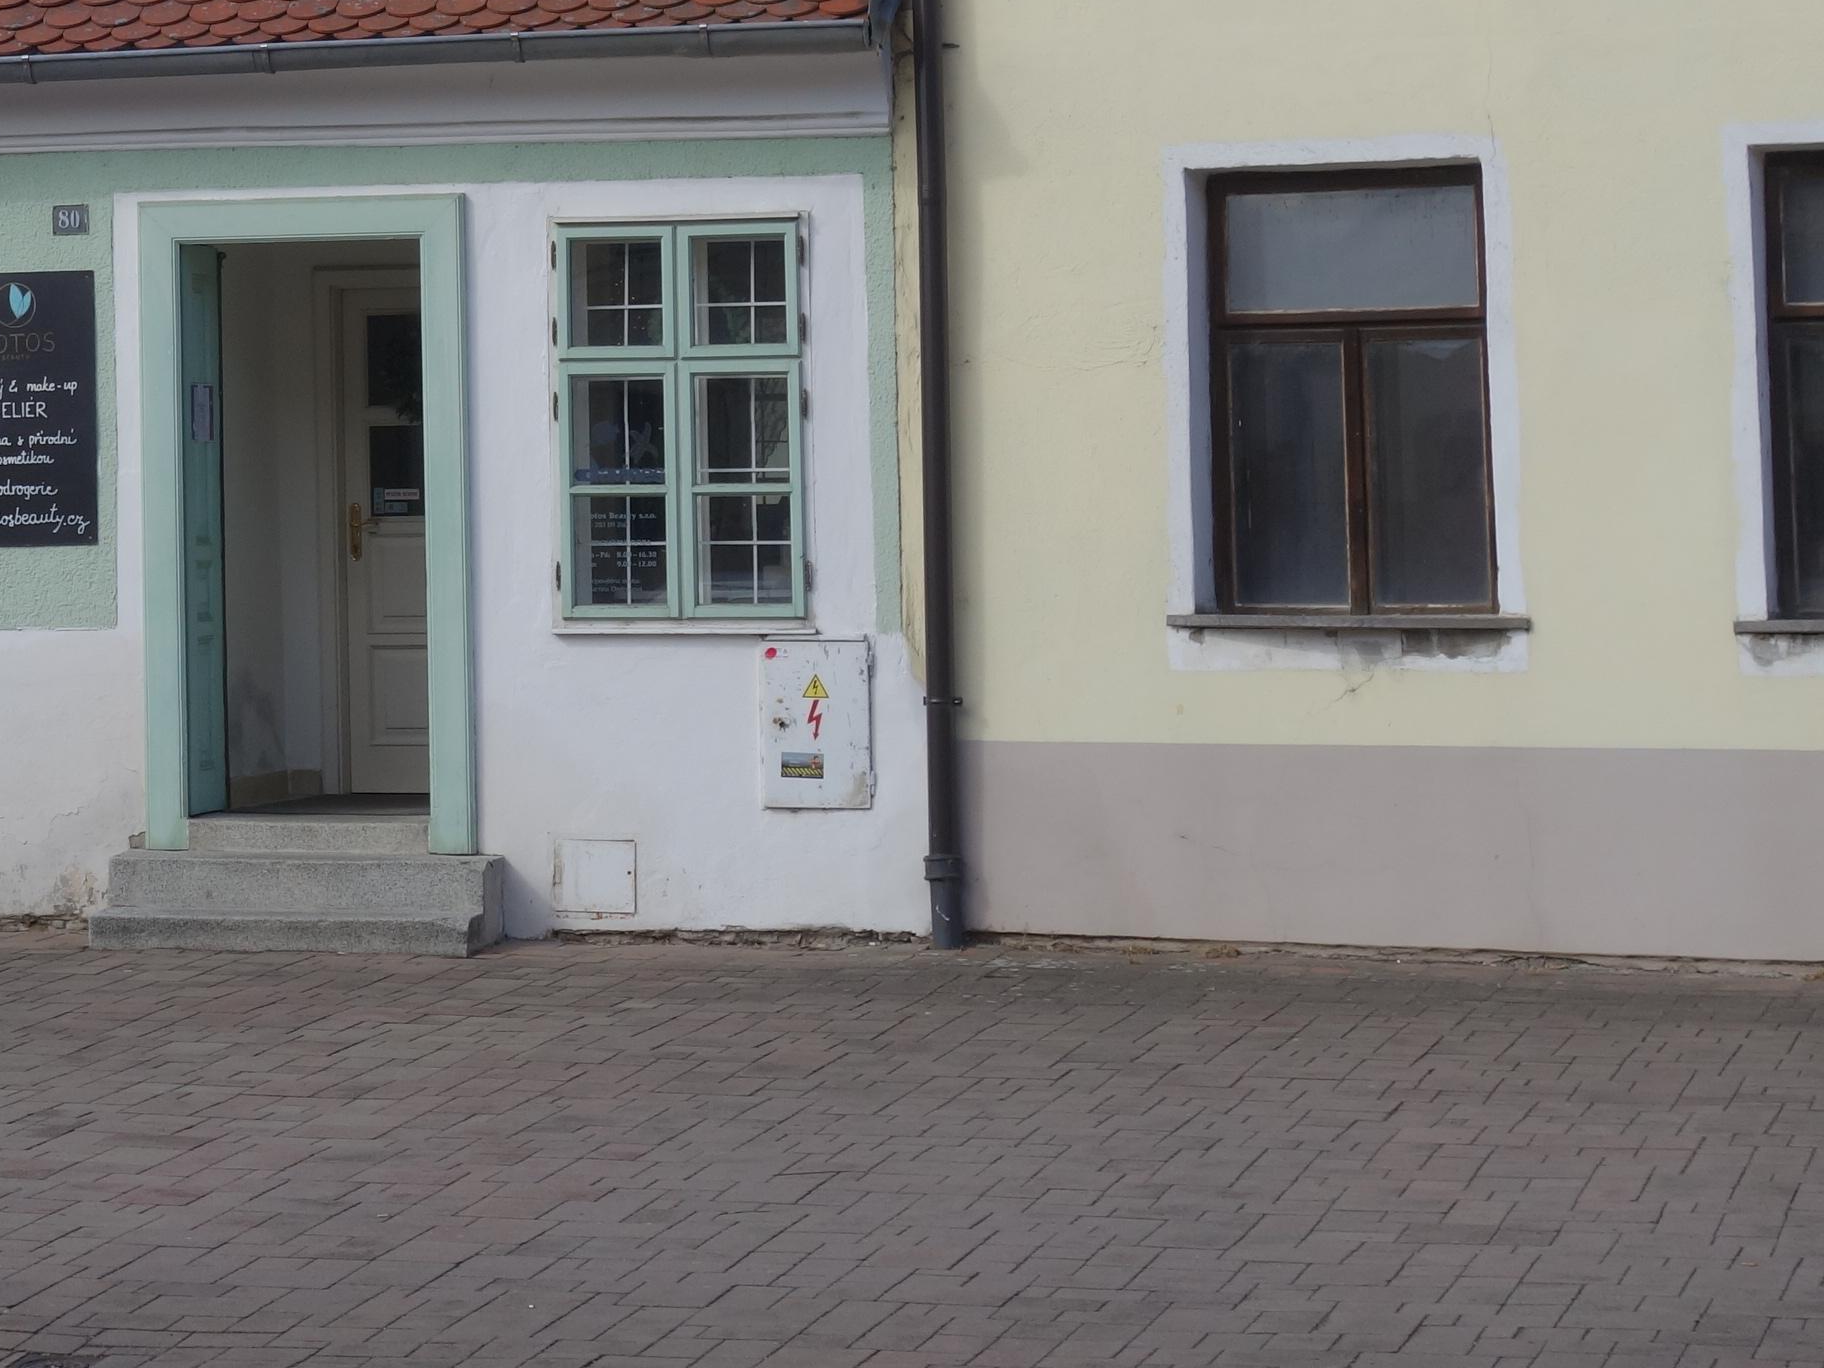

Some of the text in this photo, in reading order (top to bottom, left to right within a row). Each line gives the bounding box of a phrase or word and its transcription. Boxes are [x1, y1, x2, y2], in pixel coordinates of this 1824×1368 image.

[58, 209, 80, 229] 80
[8, 379, 18, 393] &
[17, 435, 24, 446] s
